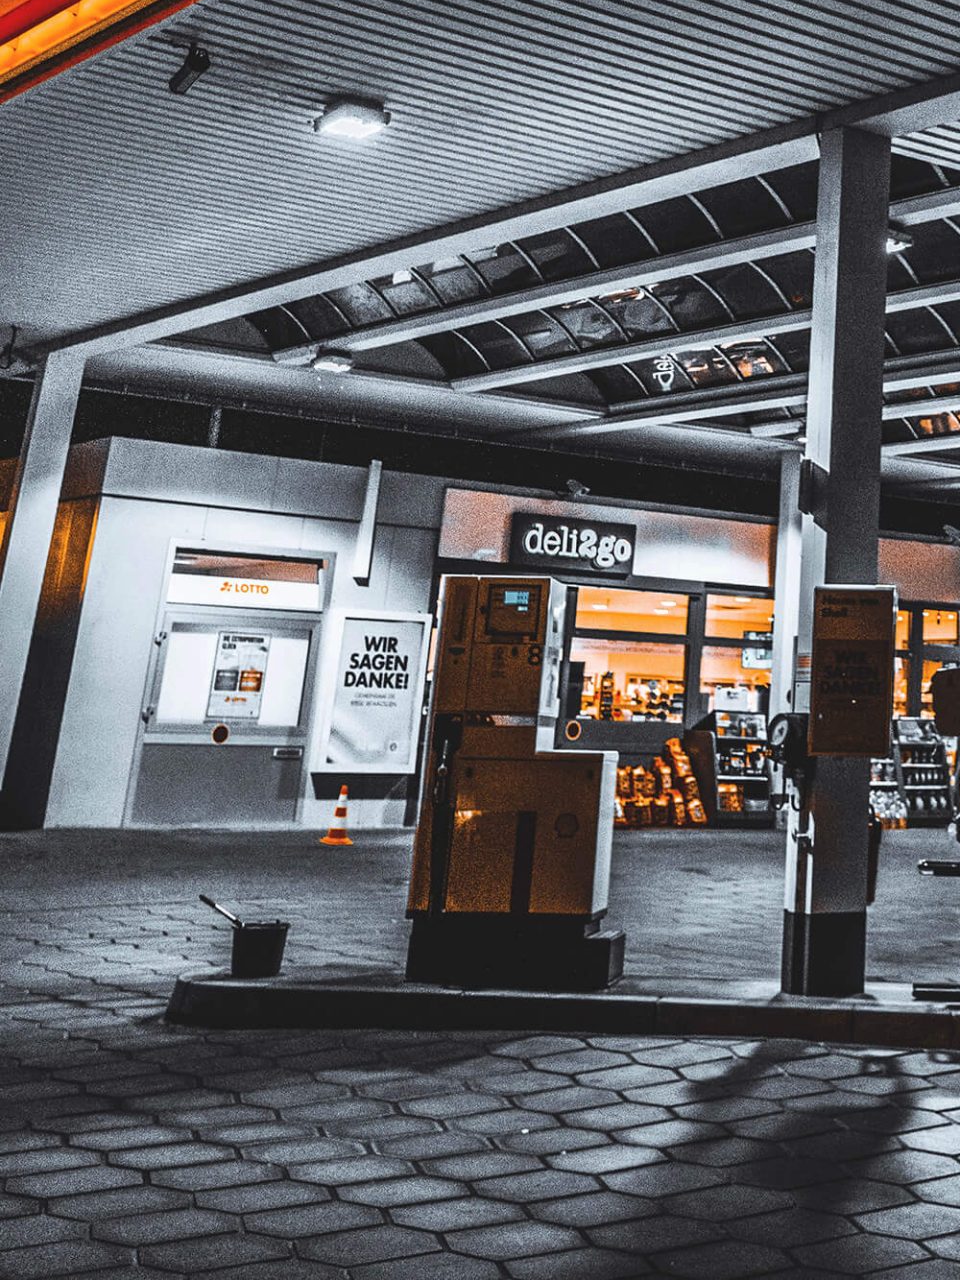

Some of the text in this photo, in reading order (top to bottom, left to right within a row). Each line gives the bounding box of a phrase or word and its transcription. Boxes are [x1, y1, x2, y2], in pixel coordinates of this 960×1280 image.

[524, 523, 632, 568] deli2go
[235, 583, 269, 595] LOTTO
[364, 635, 398, 653] WIR
[350, 653, 409, 671] SAGEN
[344, 671, 409, 690] DANKE!
